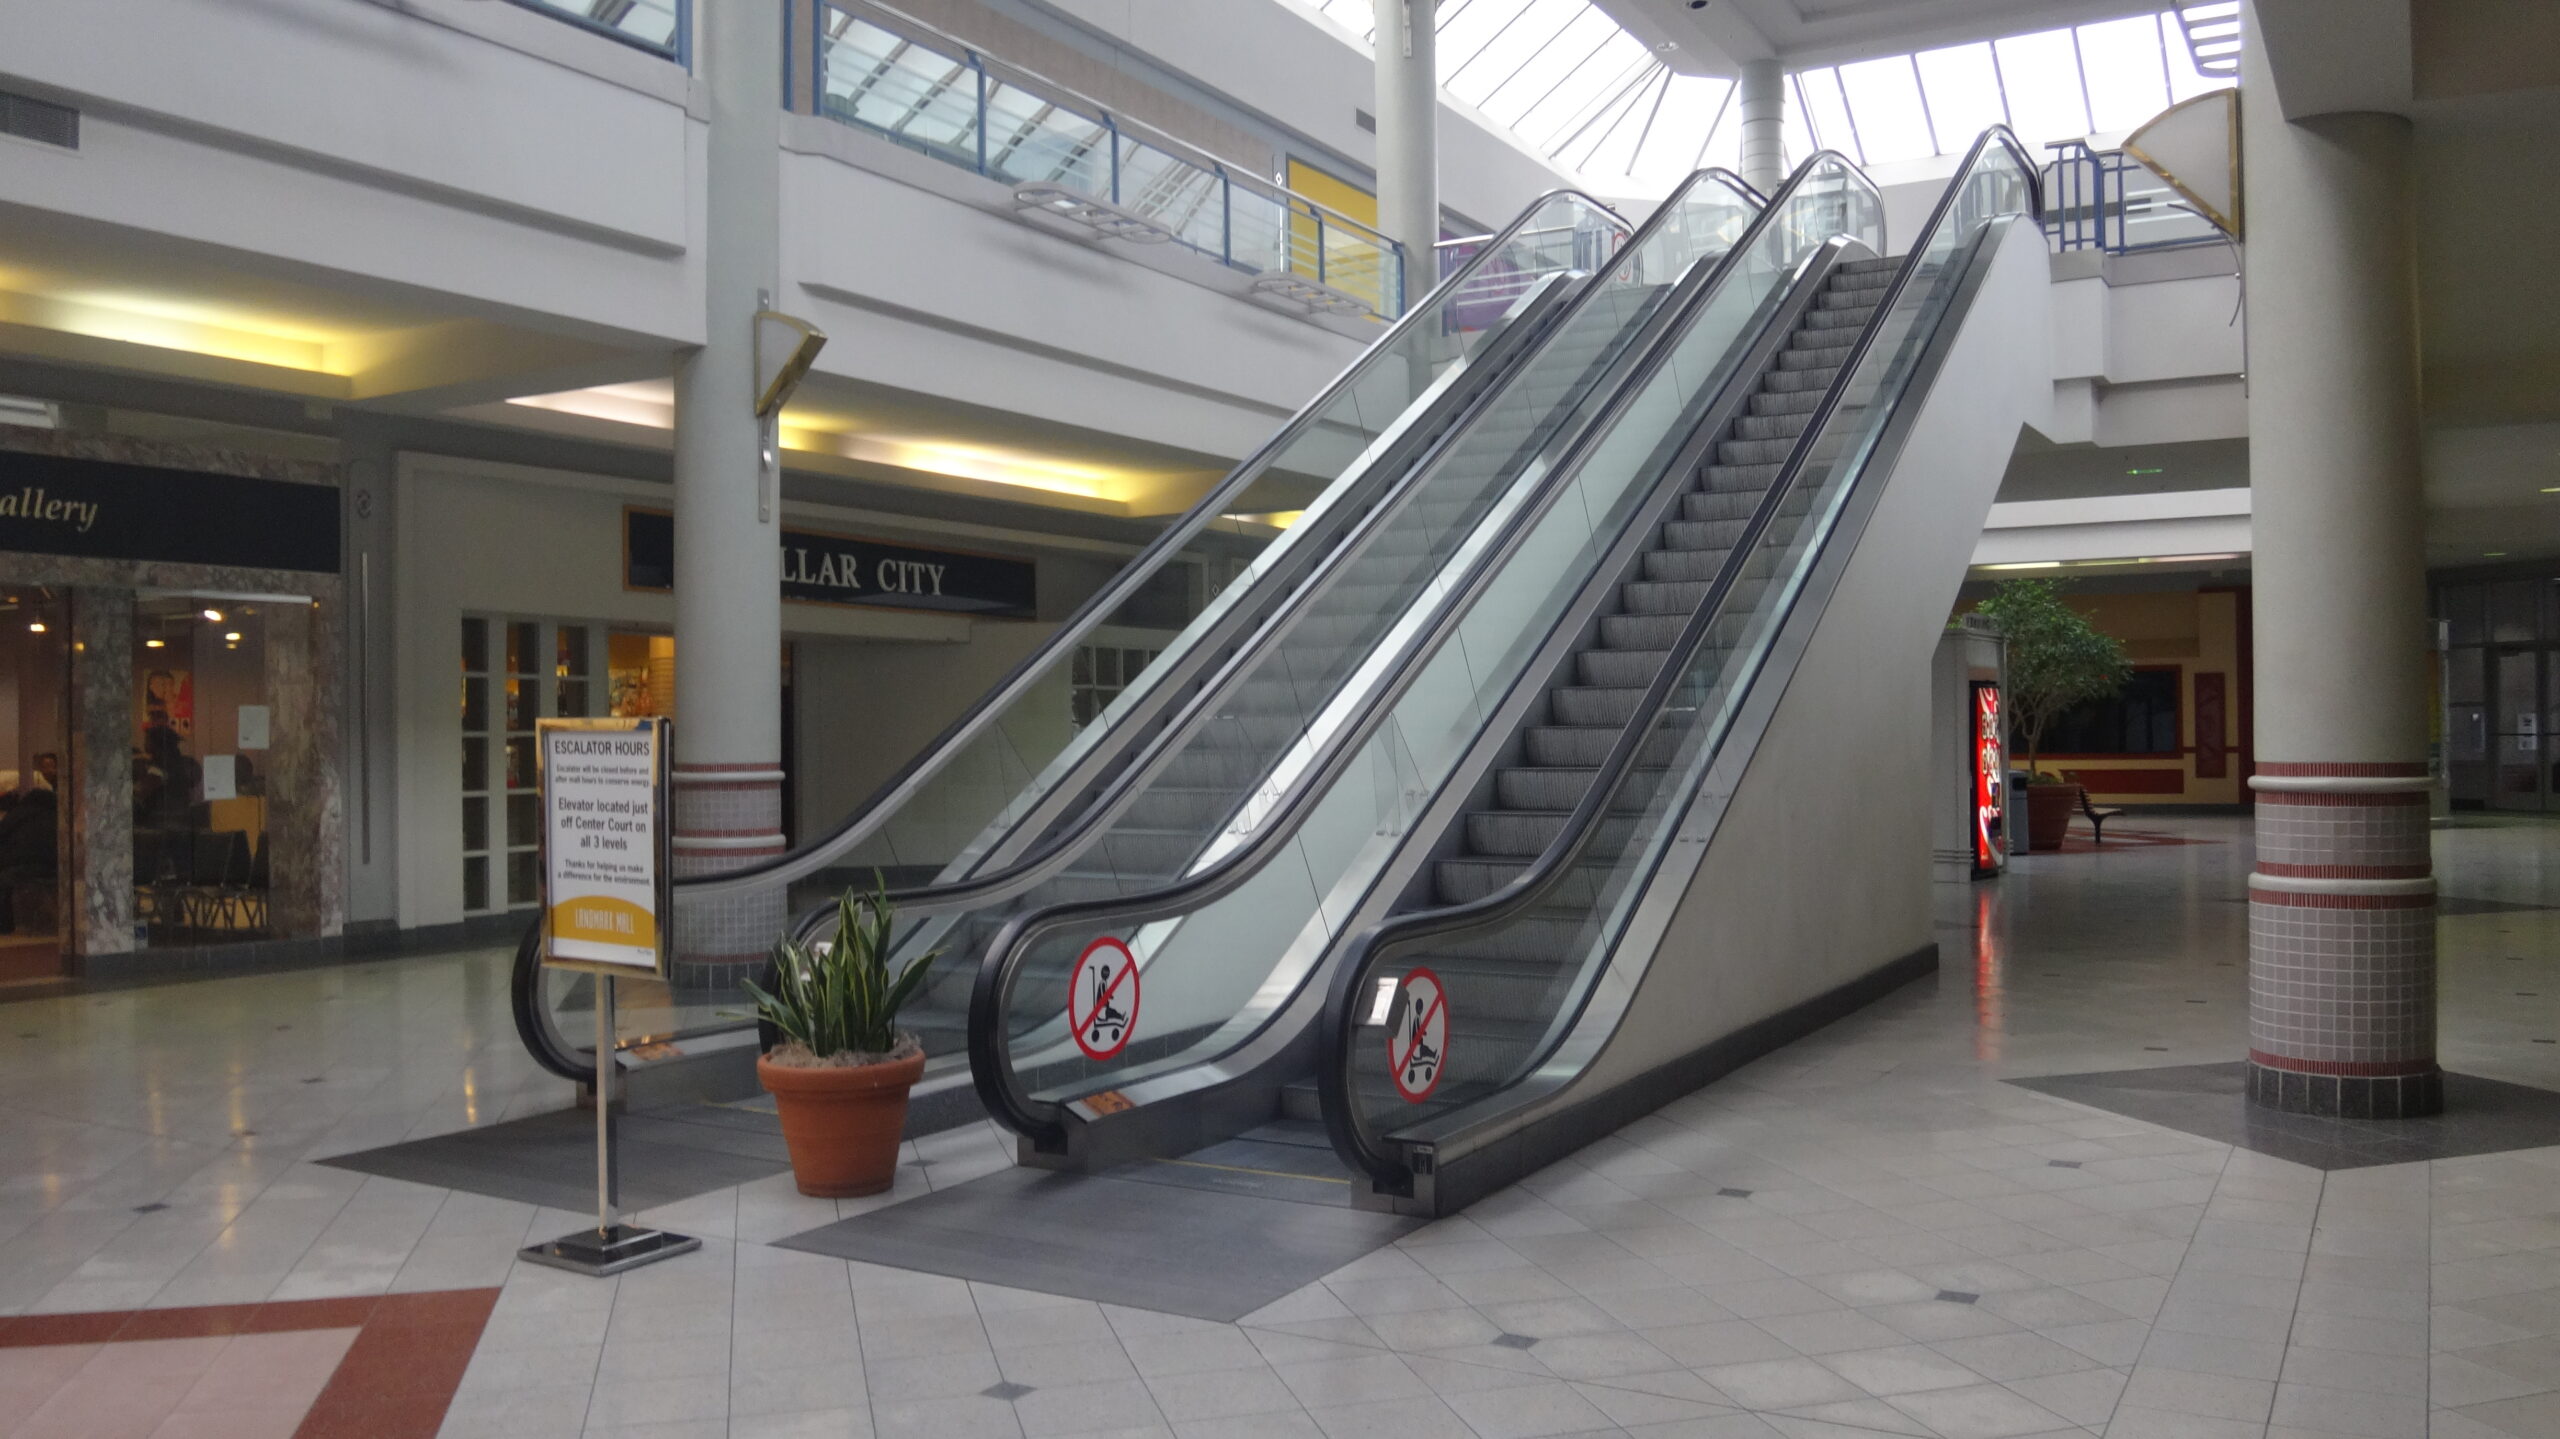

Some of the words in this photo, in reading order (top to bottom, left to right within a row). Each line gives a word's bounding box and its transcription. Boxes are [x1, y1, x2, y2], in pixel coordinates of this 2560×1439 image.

[0, 487, 99, 533] allery
[780, 547, 861, 589] LLAR
[877, 558, 945, 596] CITY
[555, 740, 612, 755] ESCALATOR
[615, 741, 650, 756] HOURS
[558, 797, 594, 812] Elevator
[597, 798, 630, 814] located
[632, 800, 648, 816] just
[561, 815, 573, 829] off
[575, 816, 605, 830] Center
[608, 818, 633, 832] Court
[635, 822, 646, 833] on
[580, 835, 591, 848] all
[594, 835, 600, 849] 3
[602, 836, 628, 850] levels
[565, 859, 586, 869] Thanks
[627, 864, 644, 873] make
